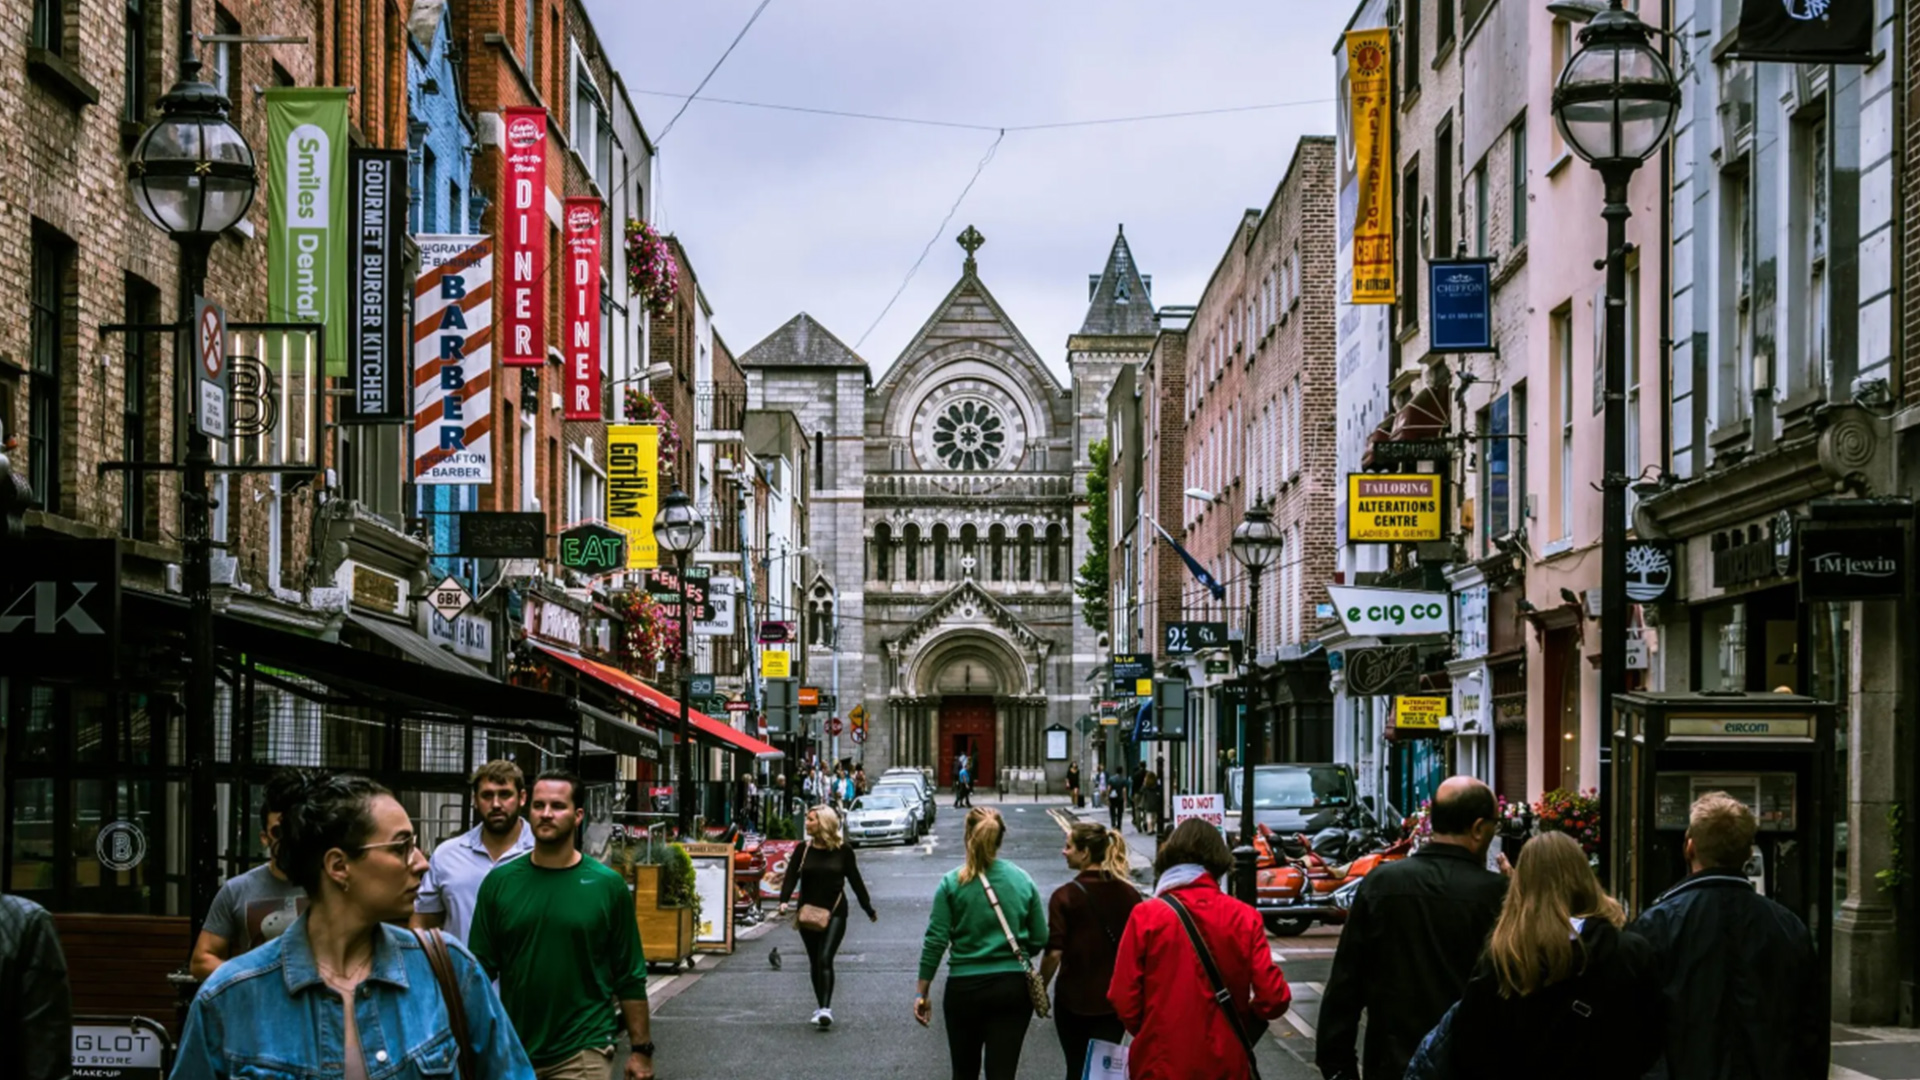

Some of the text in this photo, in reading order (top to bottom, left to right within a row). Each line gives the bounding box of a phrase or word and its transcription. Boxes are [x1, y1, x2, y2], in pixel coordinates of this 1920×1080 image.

[1367, 107, 1380, 230] ALTERATION
[297, 138, 321, 317] Smiles Dental
[432, 243, 487, 254] GRAFTON
[1357, 239, 1389, 261] CENTRE
[433, 258, 482, 268] BARBER
[514, 179, 532, 355] DINER
[362, 160, 384, 413] GOURMET BURGER KITCHEN
[1436, 284, 1482, 293] CHIFFON
[574, 259, 591, 411] DINER
[439, 275, 467, 450] BARBER
[432, 467, 481, 477] BARBER
[610, 443, 650, 518] GOTHAM
[1364, 482, 1428, 495] TAILORING
[1358, 500, 1435, 513] ALTERATIONS
[1374, 515, 1418, 527] CENTRE
[1358, 529, 1435, 538] LADIES & GENTS
[564, 535, 621, 565] EAT
[684, 568, 708, 578] INES
[437, 592, 461, 605] GBK
[1347, 603, 1442, 625] e cig co
[1725, 722, 1769, 733] eircom
[1182, 797, 1214, 809] DO NOT
[112, 832, 132, 861] B
[76, 1035, 151, 1052] GLOT
[91, 1056, 132, 1064] STORE
